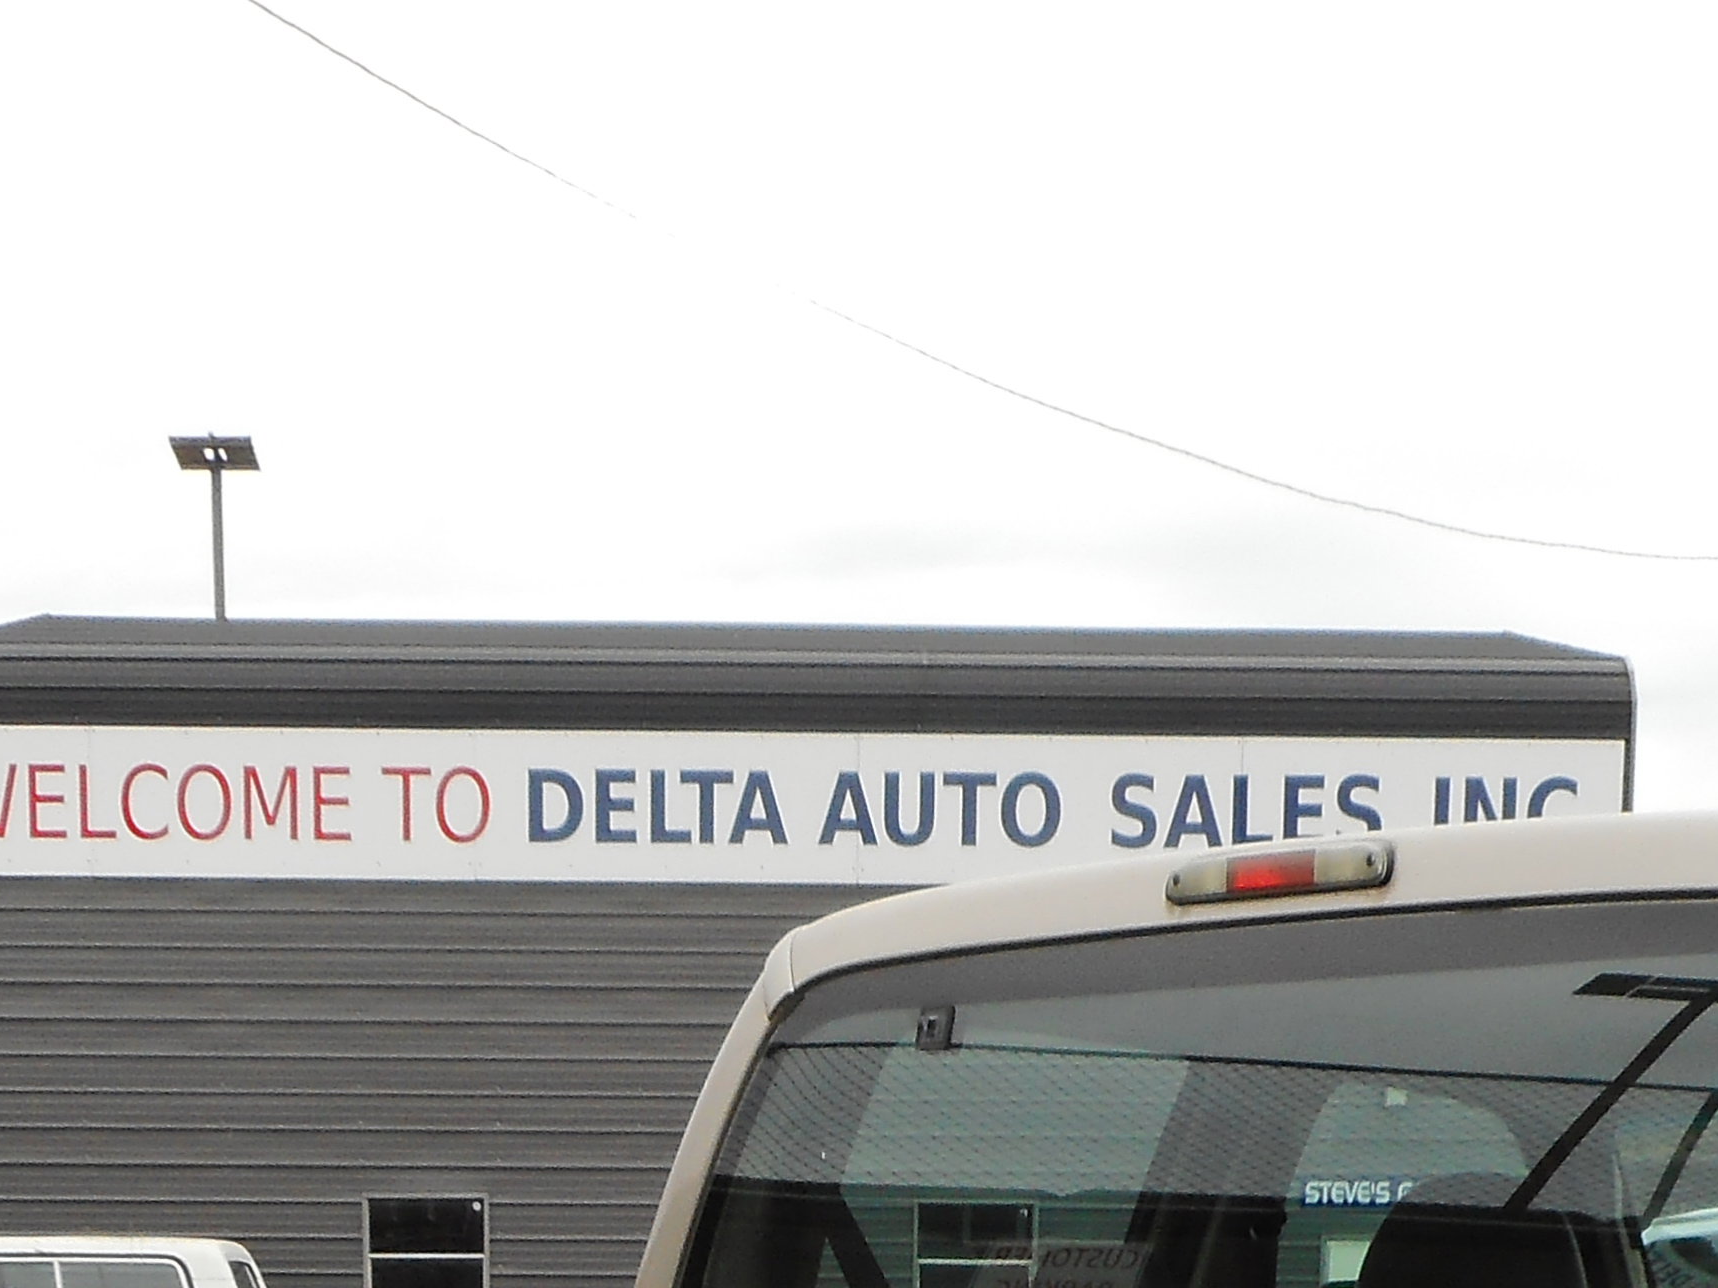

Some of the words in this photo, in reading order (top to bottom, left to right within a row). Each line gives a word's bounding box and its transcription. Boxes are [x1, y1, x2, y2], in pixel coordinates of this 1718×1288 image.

[381, 766, 491, 843] TO
[527, 768, 789, 845] DELTA
[818, 770, 1062, 848] AUTO
[1110, 773, 1384, 849] SALES
[1304, 1181, 1391, 1205] STEVE'S
